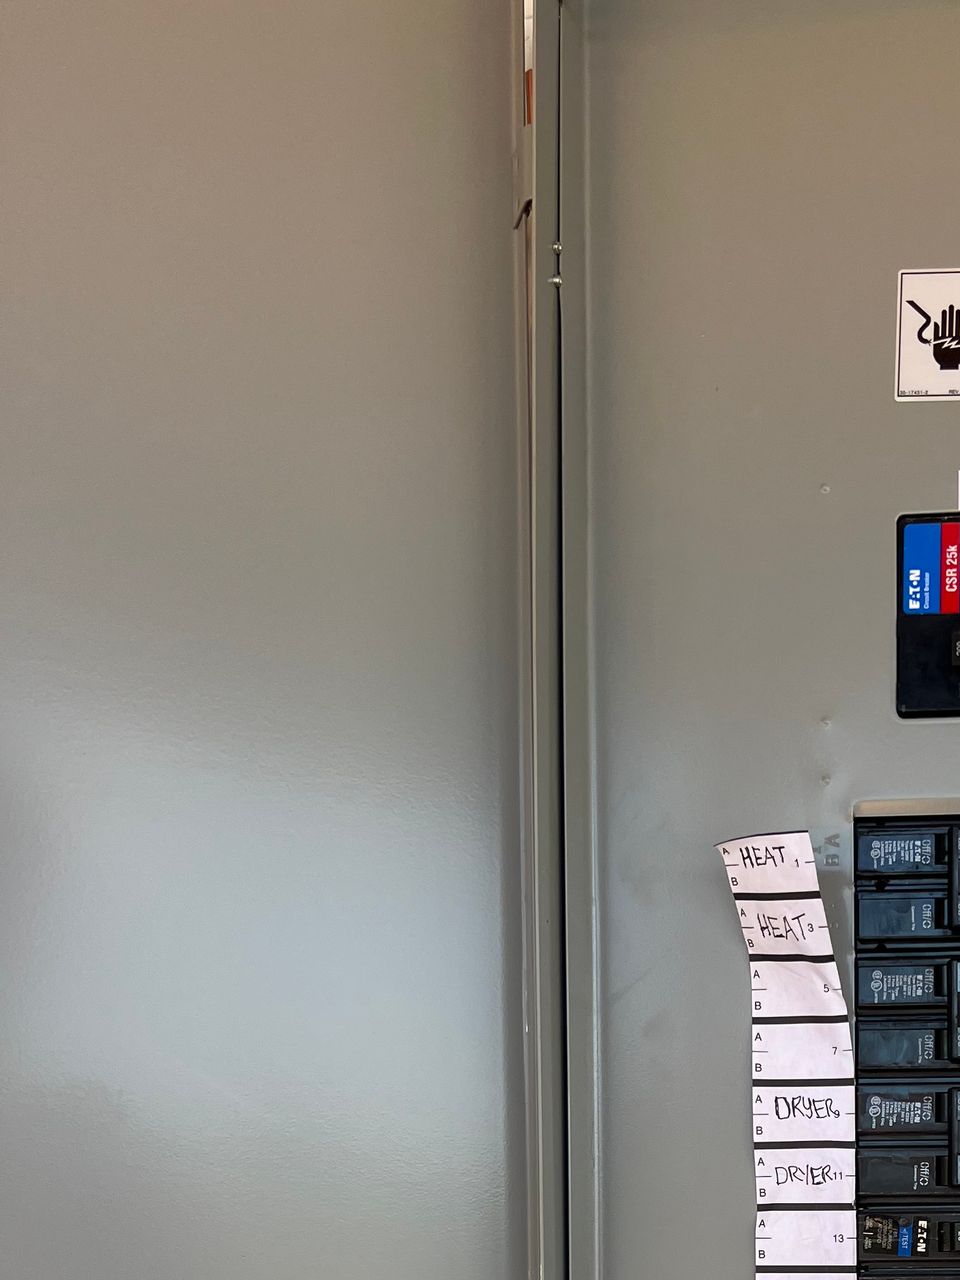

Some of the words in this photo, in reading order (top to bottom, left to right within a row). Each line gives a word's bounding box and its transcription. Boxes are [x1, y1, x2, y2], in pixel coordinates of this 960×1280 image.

[946, 545, 958, 565] 25k
[946, 568, 958, 592] CSR
[739, 846, 786, 869] HEAT
[795, 859, 799, 867] 1
[757, 913, 806, 941] HEAT
[807, 924, 814, 932] 3
[824, 984, 829, 992] 5
[832, 1047, 837, 1055] 7
[774, 1096, 834, 1120] DRYER
[774, 1164, 833, 1186] DRYER
[833, 1172, 843, 1180] 11
[833, 1234, 844, 1243] 13
